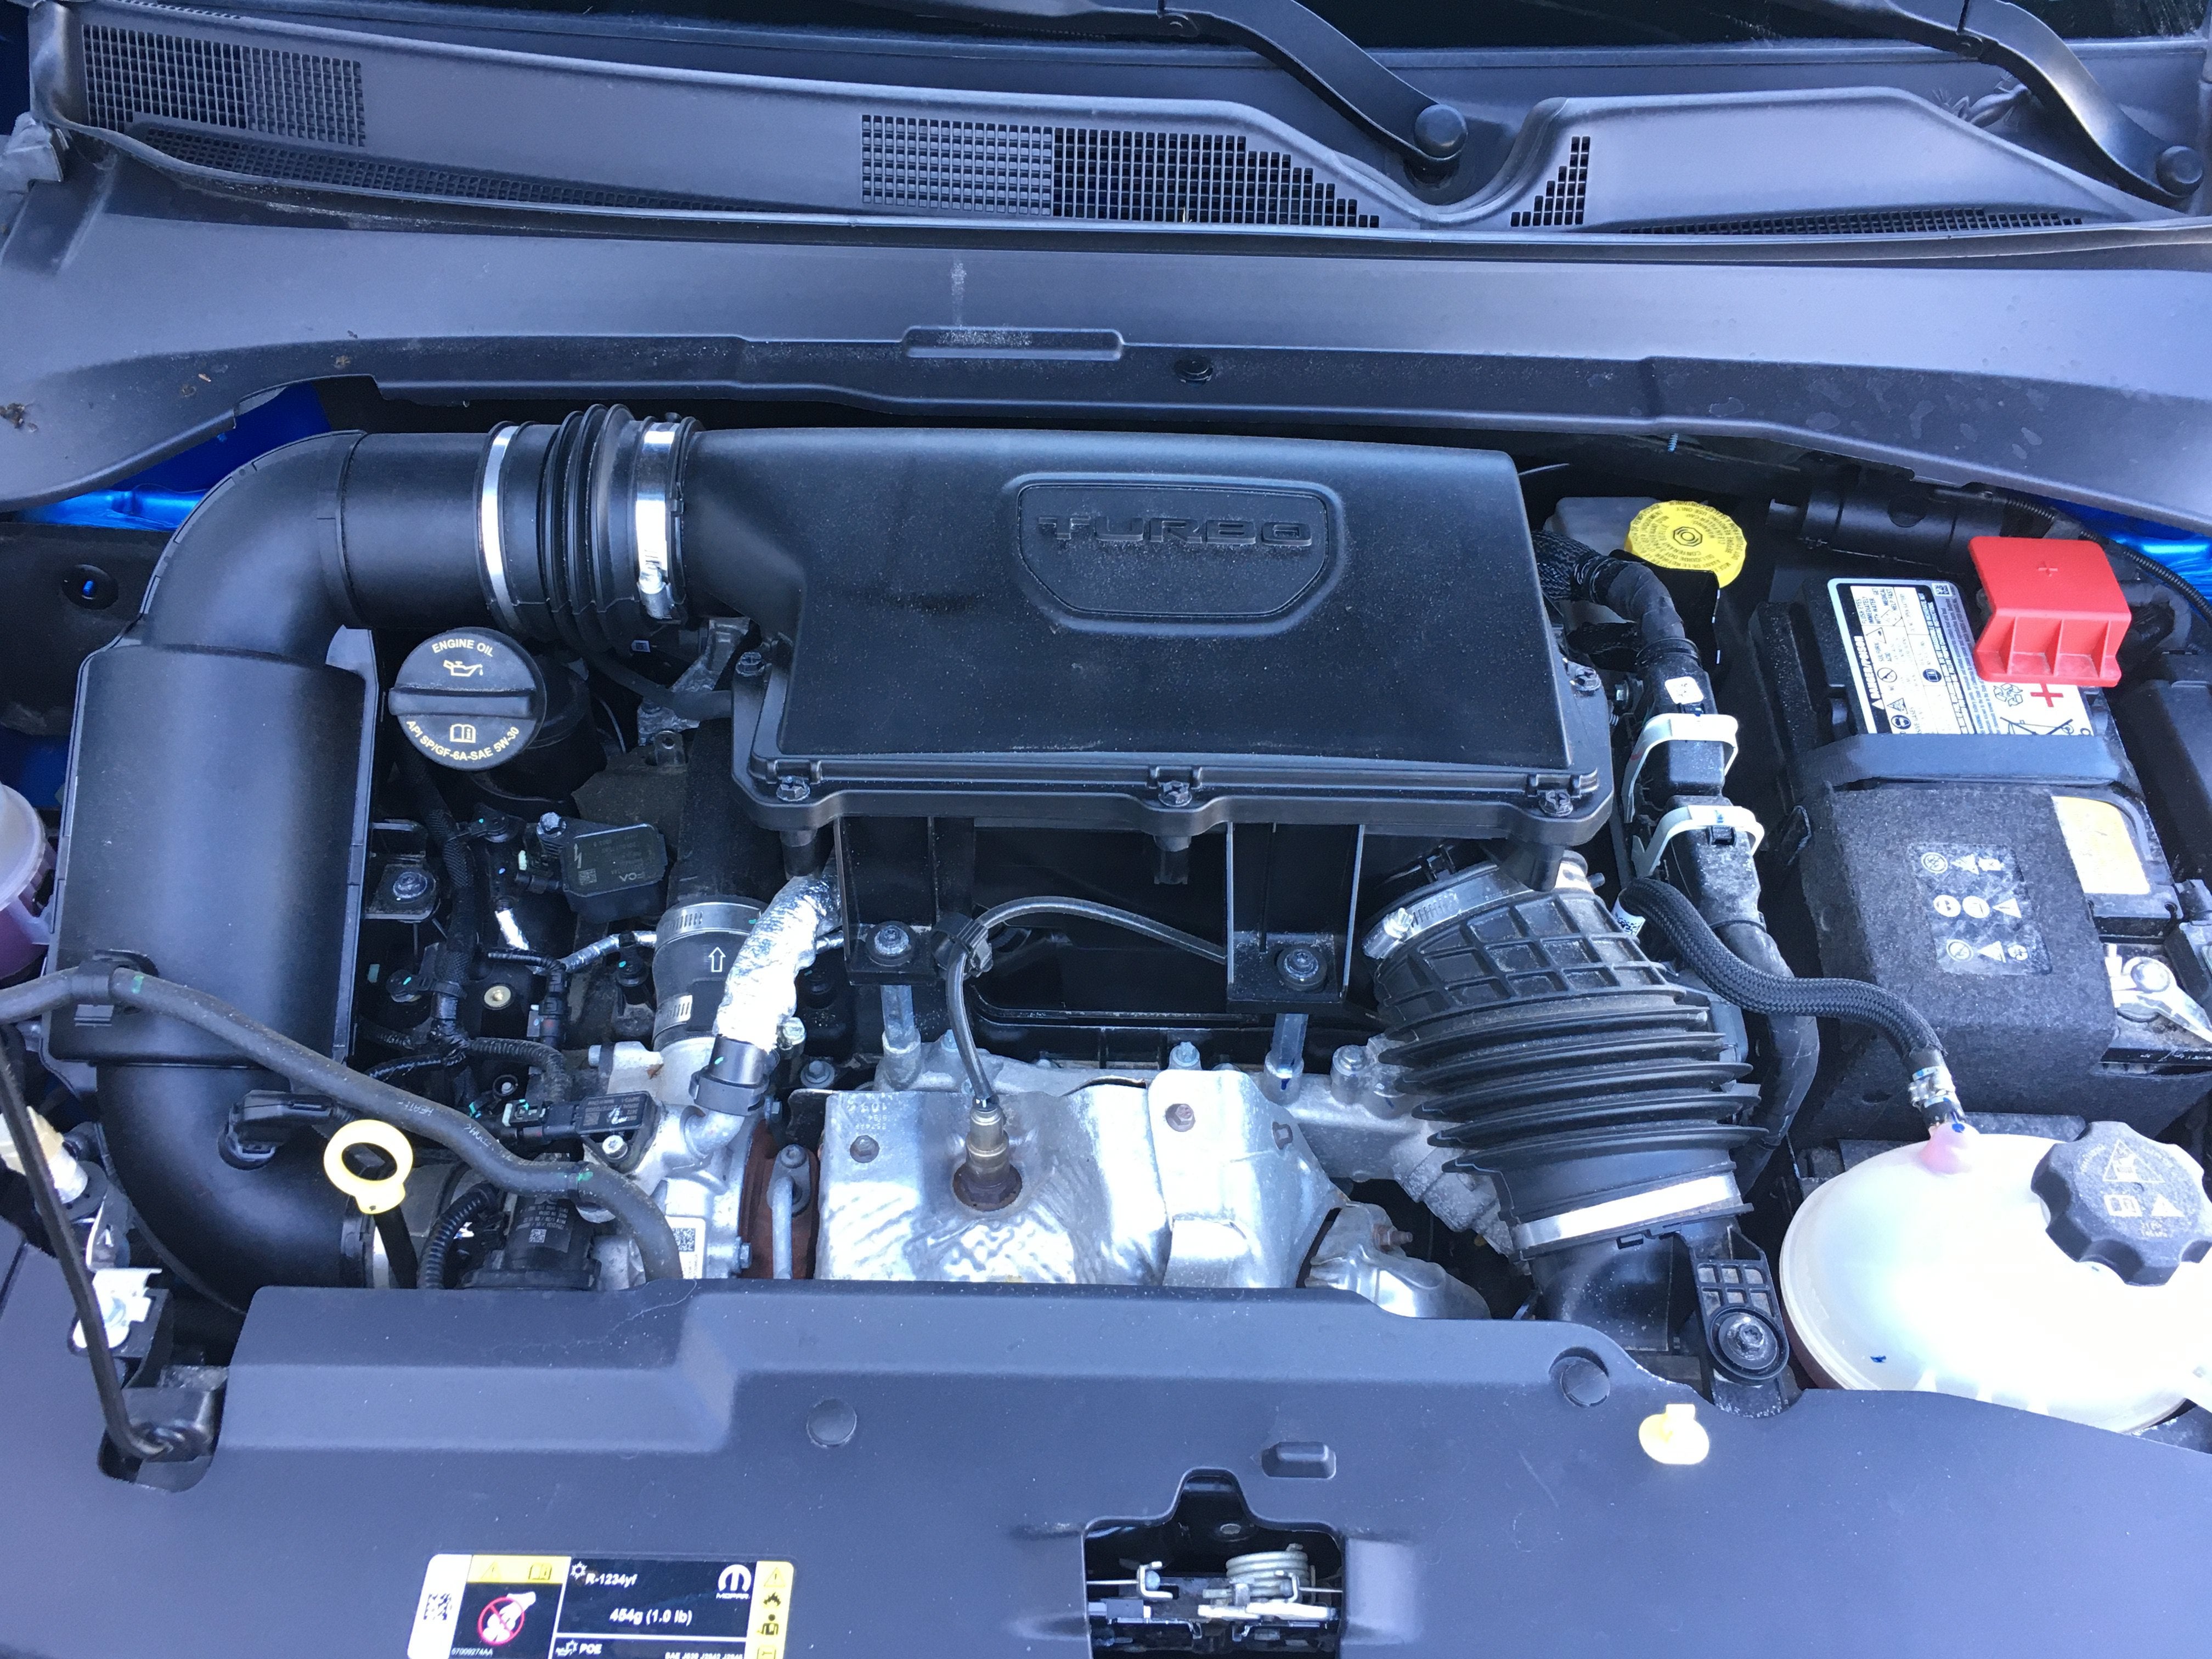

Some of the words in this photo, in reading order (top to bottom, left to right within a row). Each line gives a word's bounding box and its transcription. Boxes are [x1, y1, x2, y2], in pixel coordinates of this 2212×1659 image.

[1038, 515, 1312, 547] TURBO
[1855, 599, 1864, 609] EYES
[1869, 597, 1878, 612] WATER
[1878, 588, 1889, 606] MEDICAL
[432, 639, 475, 653] ENGINE
[477, 642, 494, 657] OIL
[1853, 636, 1880, 698] DANGER/POISON
[406, 720, 423, 738] API
[494, 726, 520, 752] 5W-30
[584, 1573, 638, 1589] R-1234yf
[609, 1607, 644, 1626] 454g
[645, 1608, 672, 1626] (1.0
[674, 1609, 693, 1627] lb)
[578, 1643, 603, 1655] POE
